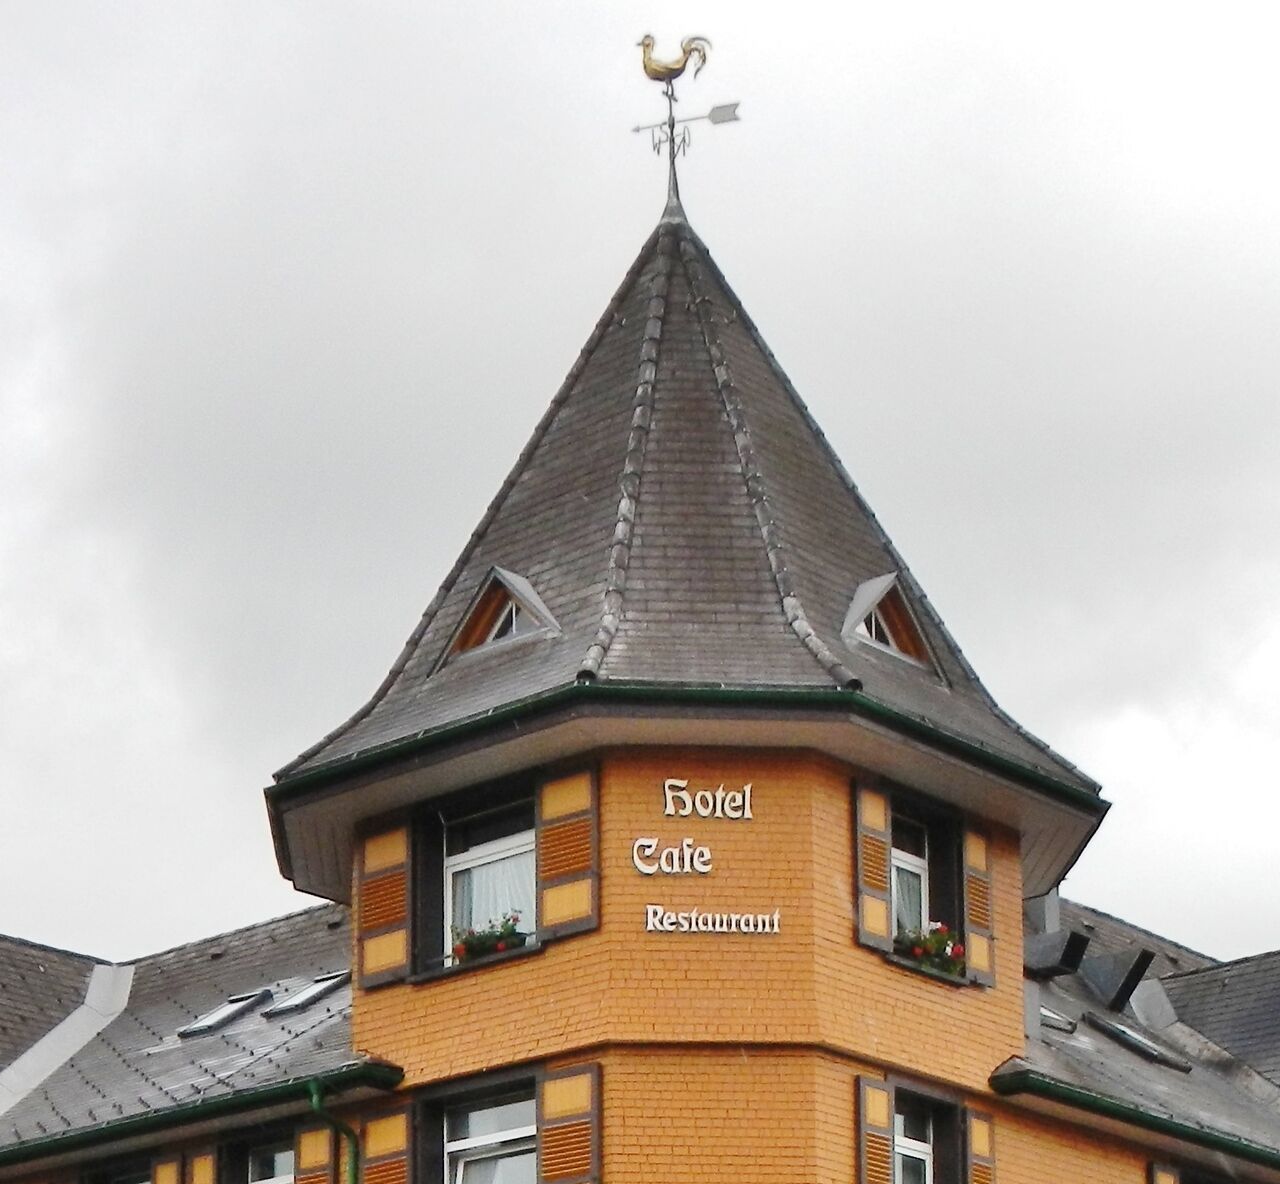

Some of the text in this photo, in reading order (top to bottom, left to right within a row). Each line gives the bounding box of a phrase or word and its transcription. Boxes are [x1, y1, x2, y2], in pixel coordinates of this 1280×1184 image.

[664, 778, 753, 820] Hotel
[632, 837, 713, 875] Cafe
[645, 904, 781, 934] Restaurant
